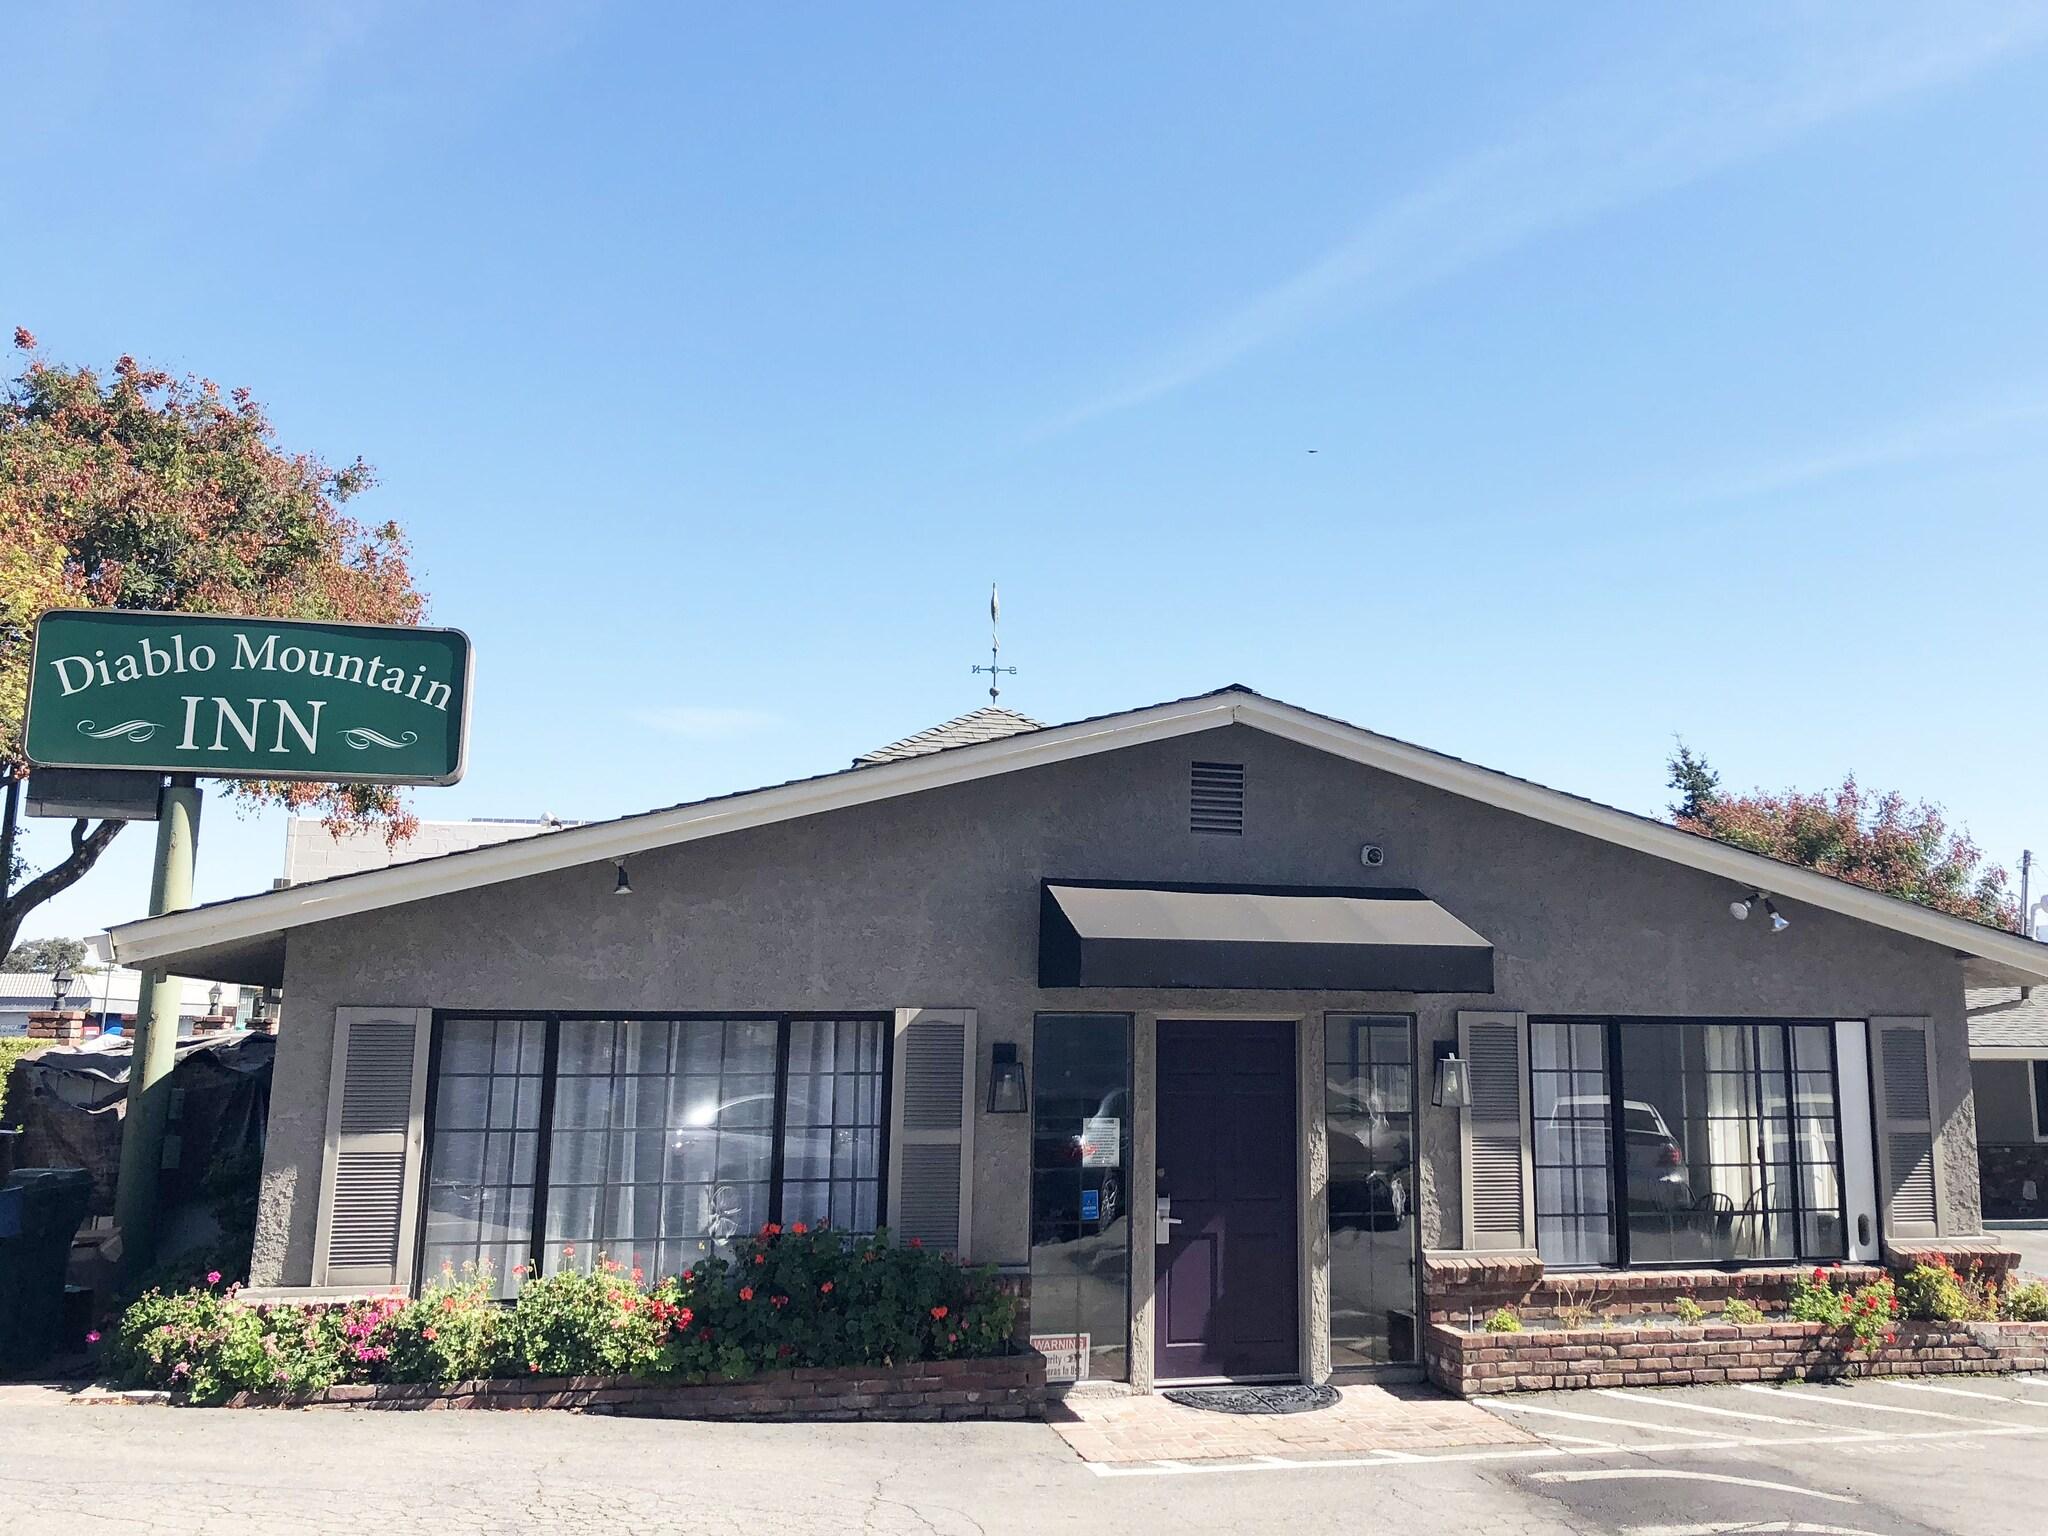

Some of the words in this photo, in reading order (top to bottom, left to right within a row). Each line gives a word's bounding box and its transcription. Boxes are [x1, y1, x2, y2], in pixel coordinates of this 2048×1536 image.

[50, 635, 216, 697] Diablo
[230, 633, 453, 712] Mountain
[175, 696, 327, 754] INN
[1034, 1338, 1085, 1351] WARNING
